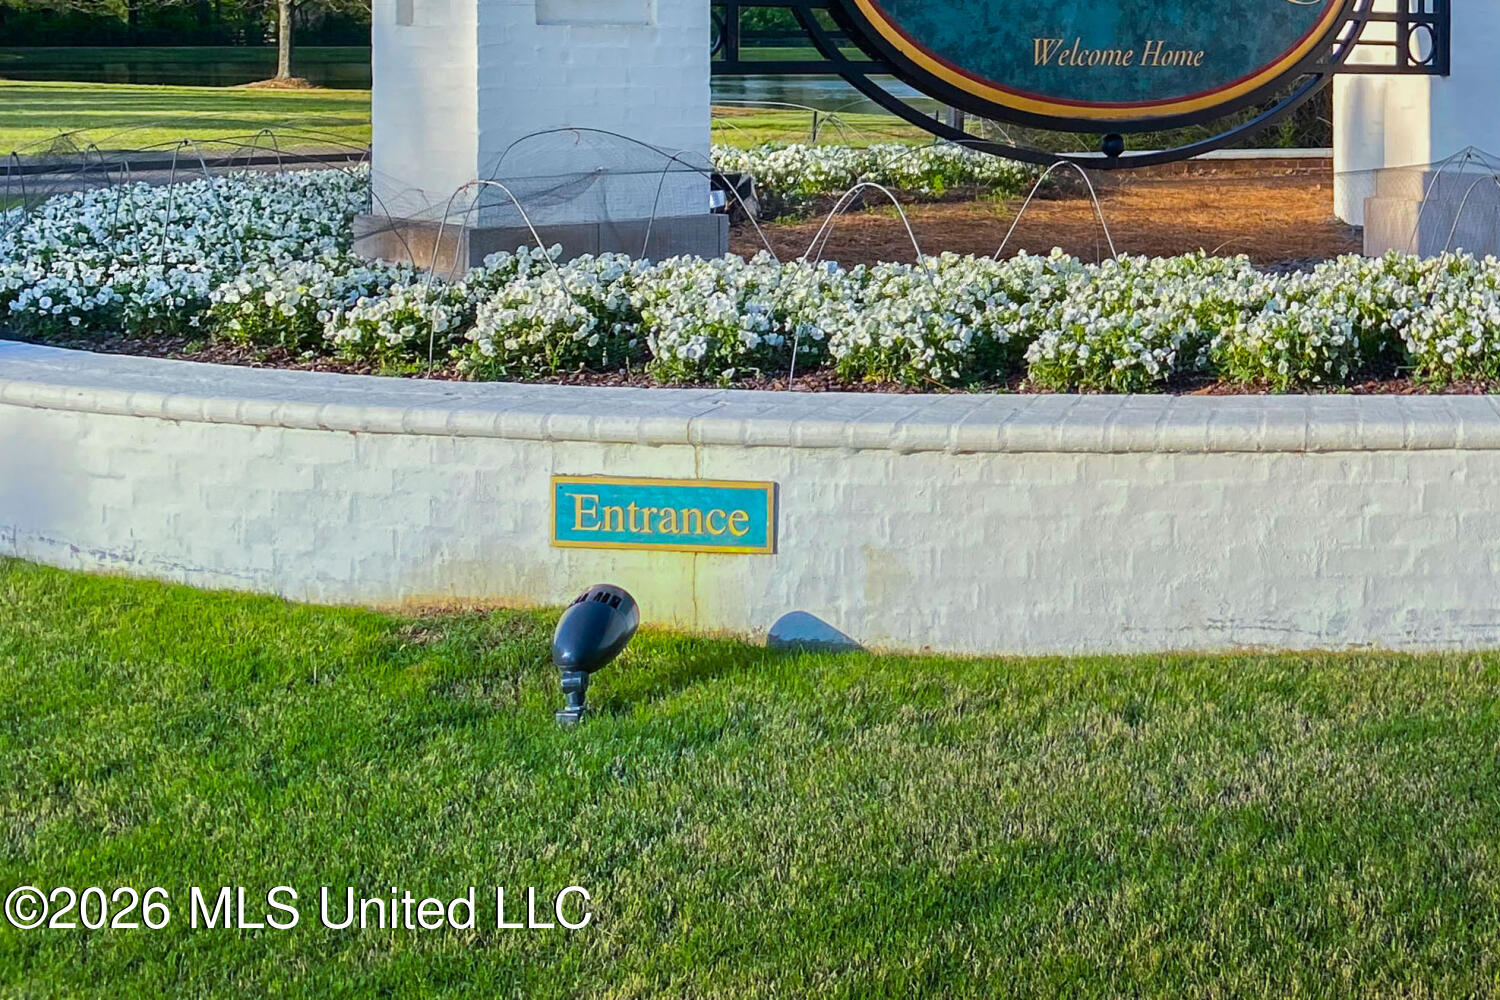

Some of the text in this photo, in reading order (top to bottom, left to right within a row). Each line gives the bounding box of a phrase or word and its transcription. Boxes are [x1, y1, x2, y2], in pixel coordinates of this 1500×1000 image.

[1032, 37, 1204, 68] Welcome Home
[565, 492, 750, 537] Entrance
